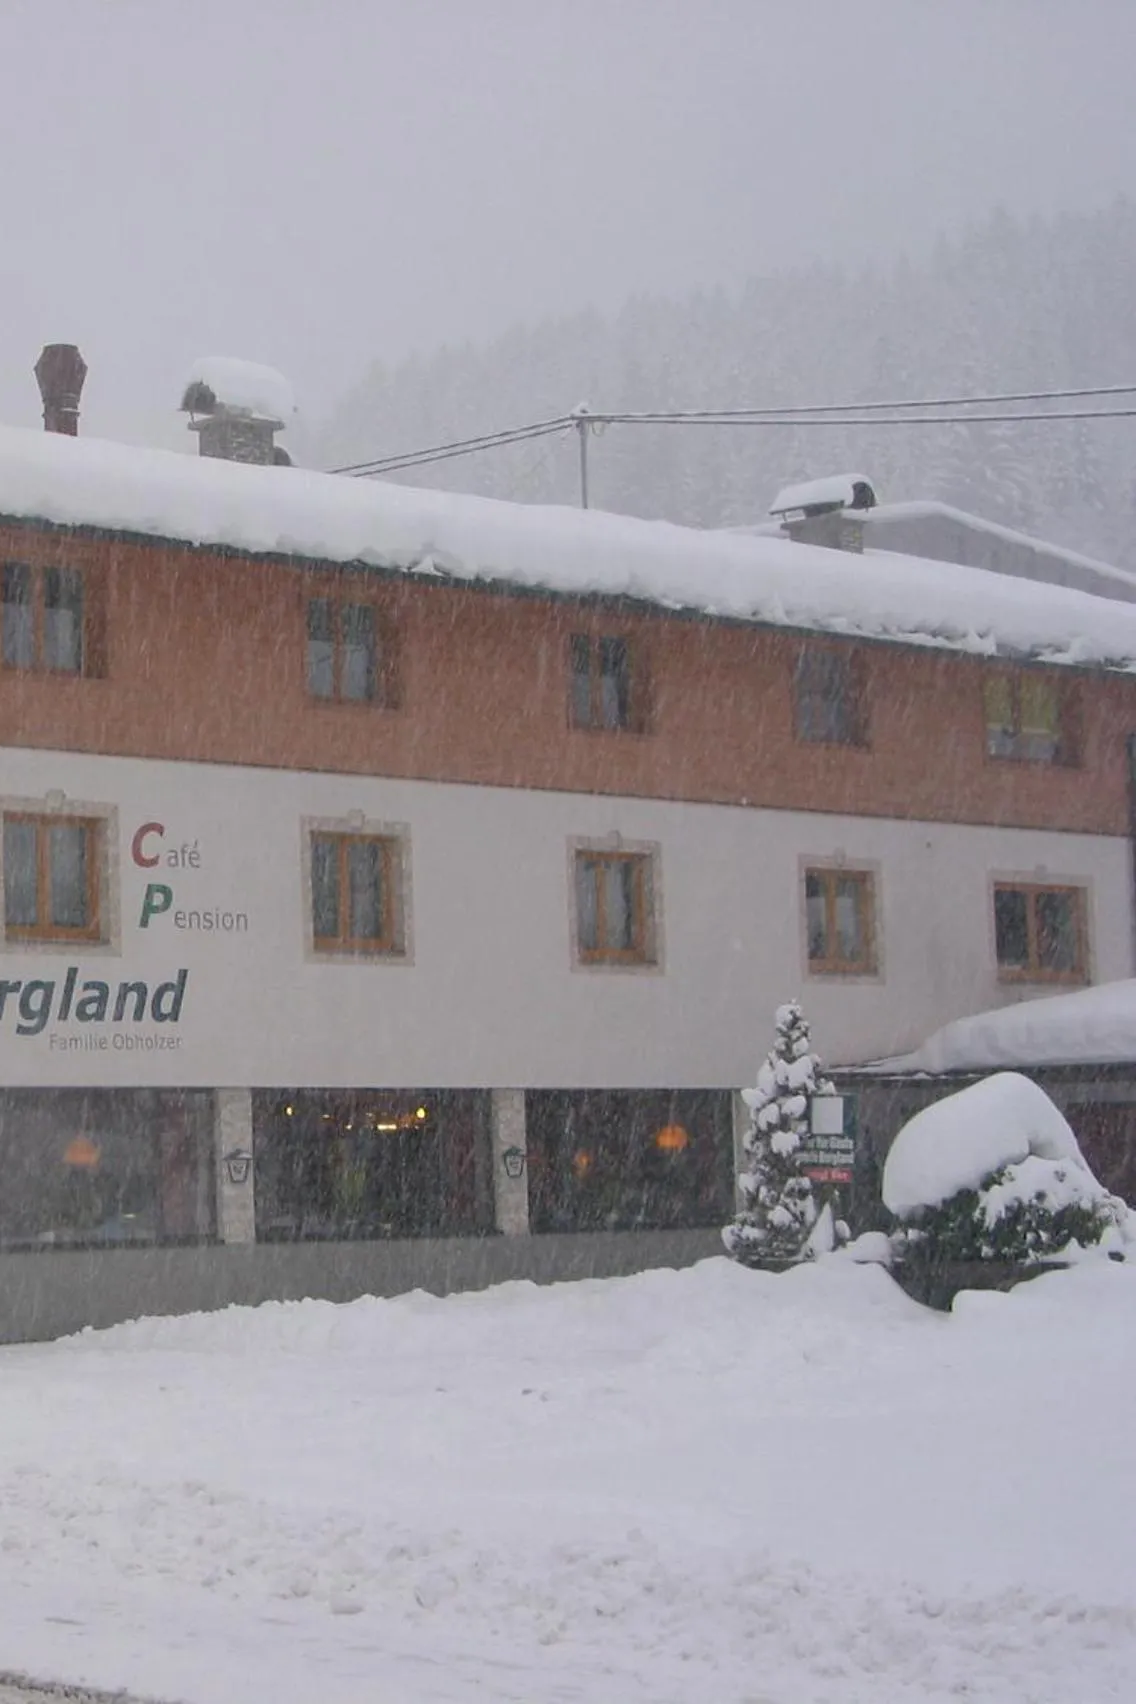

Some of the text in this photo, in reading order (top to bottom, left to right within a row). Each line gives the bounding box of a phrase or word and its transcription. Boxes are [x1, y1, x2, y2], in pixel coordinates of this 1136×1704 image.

[131, 822, 202, 869] Café
[138, 883, 249, 932] Pension
[49, 1033, 108, 1051] Familie
